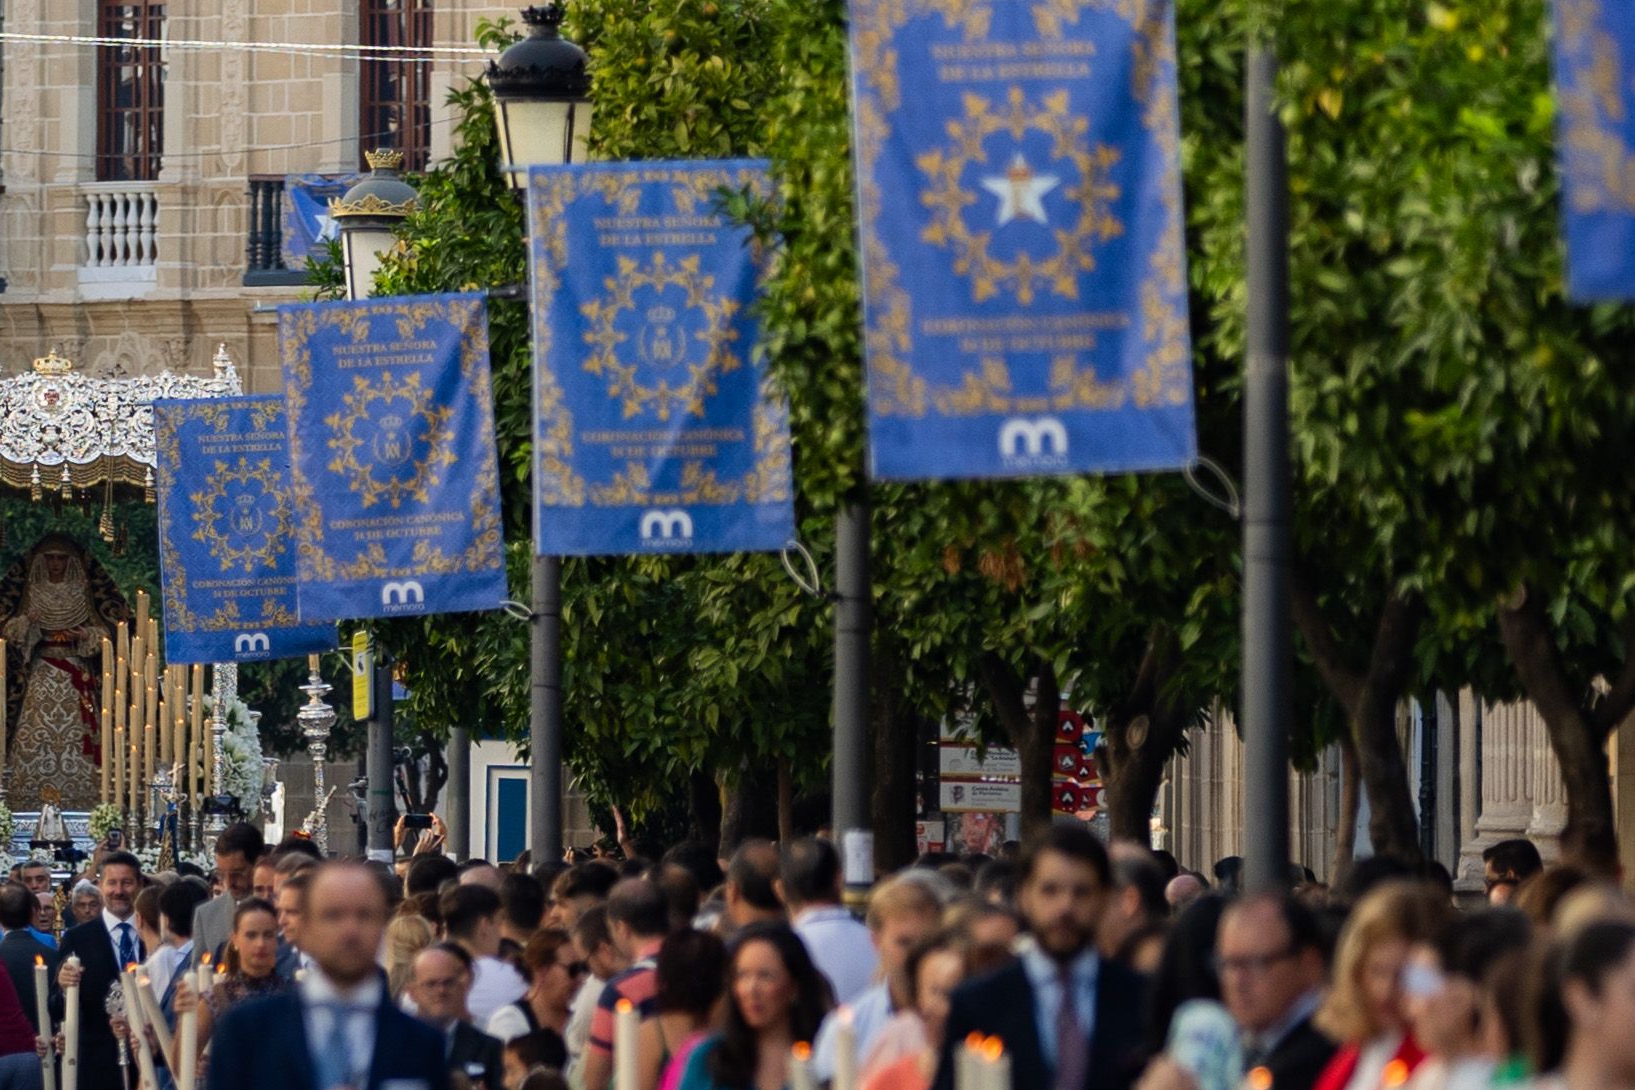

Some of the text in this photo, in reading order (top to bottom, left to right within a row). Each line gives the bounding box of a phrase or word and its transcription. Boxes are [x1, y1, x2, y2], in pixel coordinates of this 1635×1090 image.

[332, 340, 437, 355] NUESTRA SEÑORA
[338, 353, 434, 369] DE LA ESTRELLA
[198, 431, 285, 443] NUESTRA SEÑORA
[203, 443, 281, 454] DE LA ESTRELLA
[367, 529, 383, 540] DE
[386, 525, 442, 538] OCTUBRE
[240, 587, 286, 596] OCTUBRE
